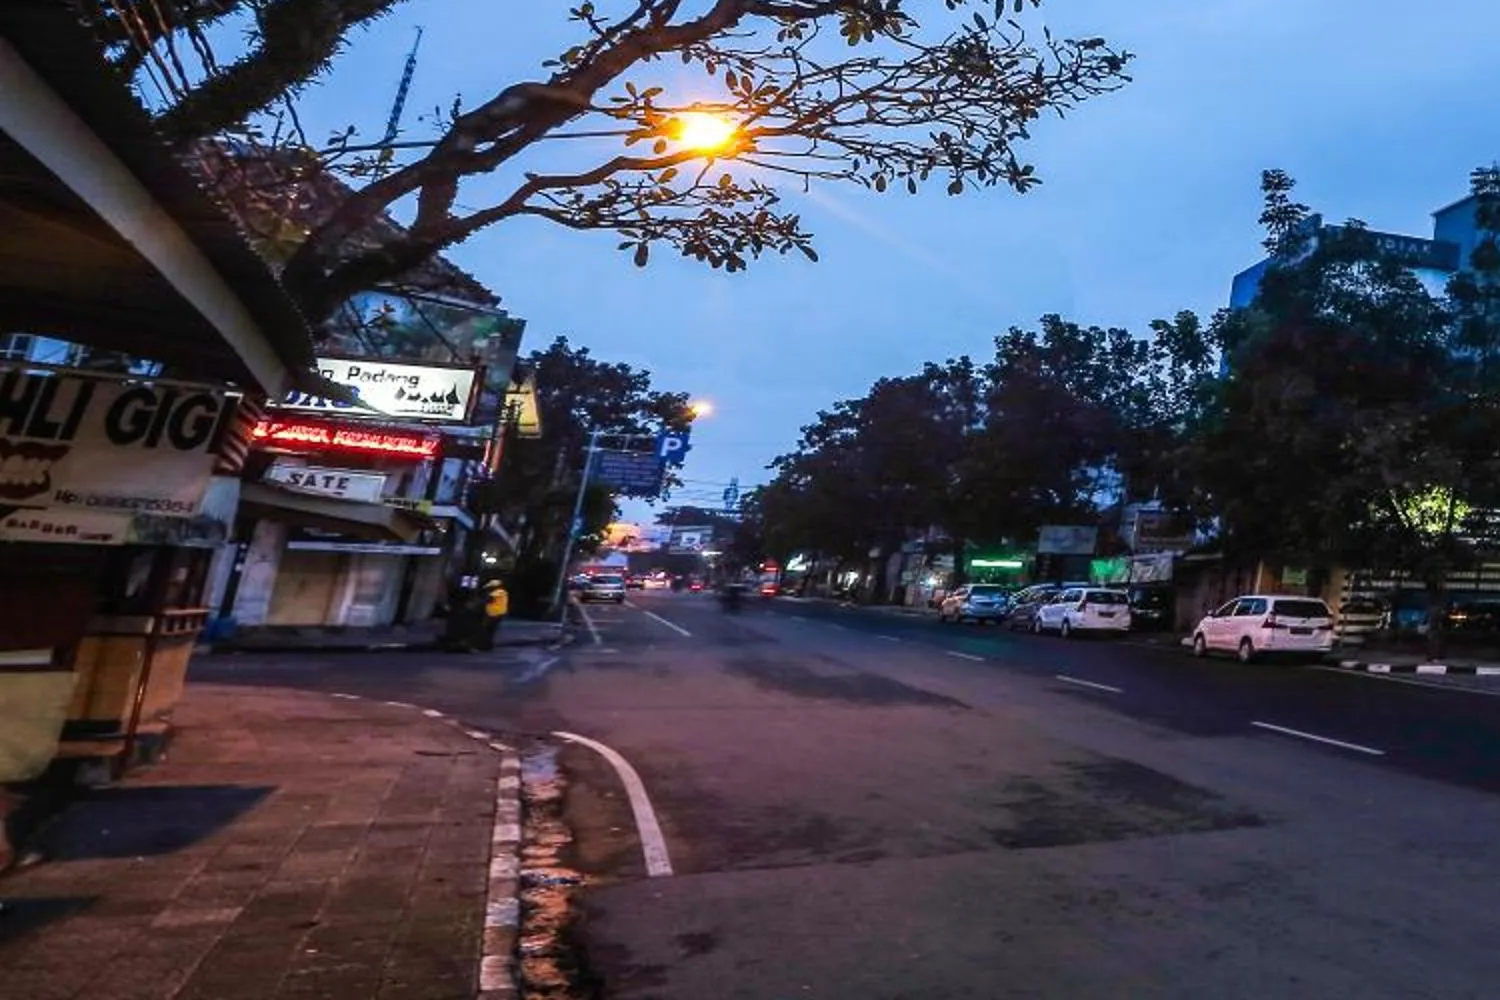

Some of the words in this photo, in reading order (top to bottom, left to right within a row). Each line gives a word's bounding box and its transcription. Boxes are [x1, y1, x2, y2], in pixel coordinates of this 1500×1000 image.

[347, 366, 420, 385] Padang
[105, 386, 239, 454] GIGI
[660, 437, 682, 457] P
[286, 472, 350, 490] SATE
